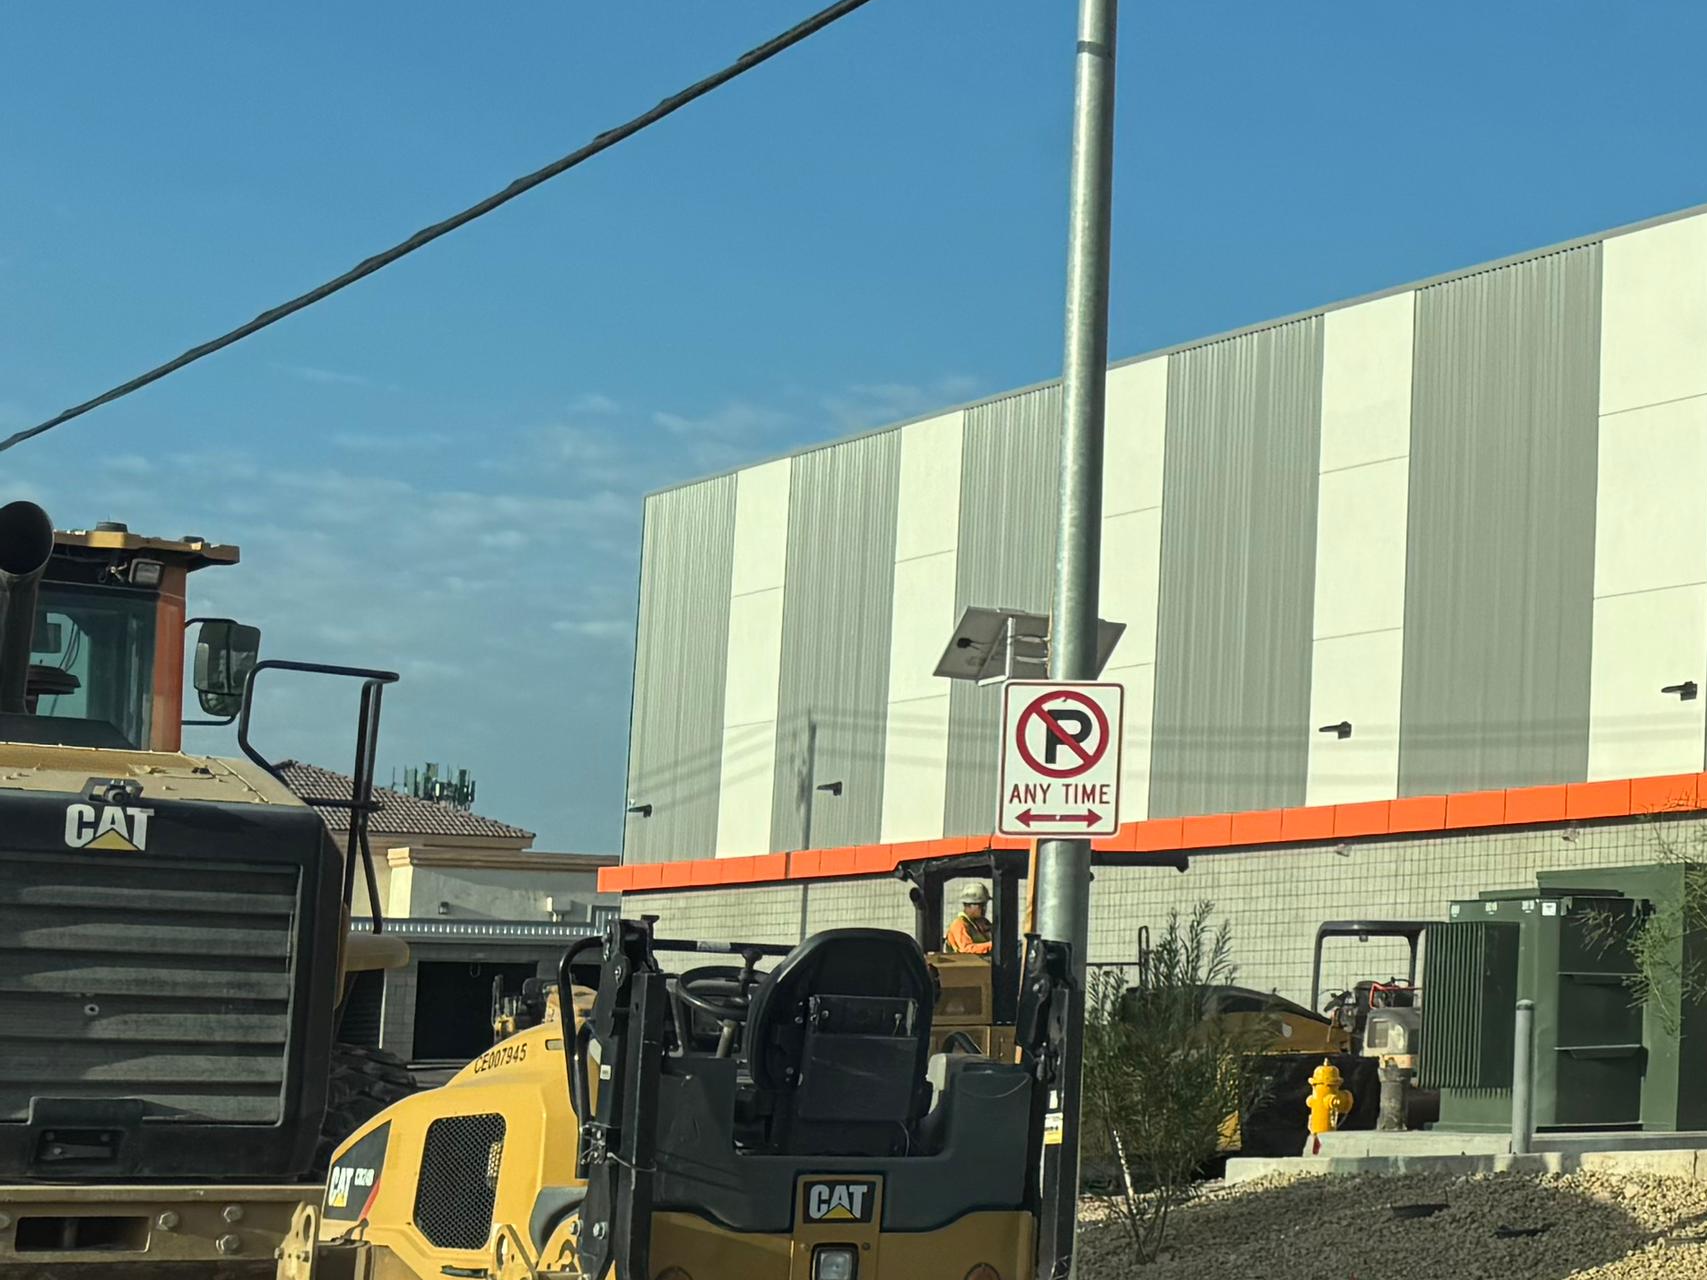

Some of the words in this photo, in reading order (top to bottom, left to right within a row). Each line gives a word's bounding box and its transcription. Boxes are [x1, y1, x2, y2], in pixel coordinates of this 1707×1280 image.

[1009, 783, 1052, 805] ANY
[1062, 783, 1111, 805] TIME
[64, 803, 155, 851] CAT
[474, 1043, 527, 1073] CE007945
[328, 1166, 354, 1207] CAT
[809, 1184, 868, 1219] CAT
